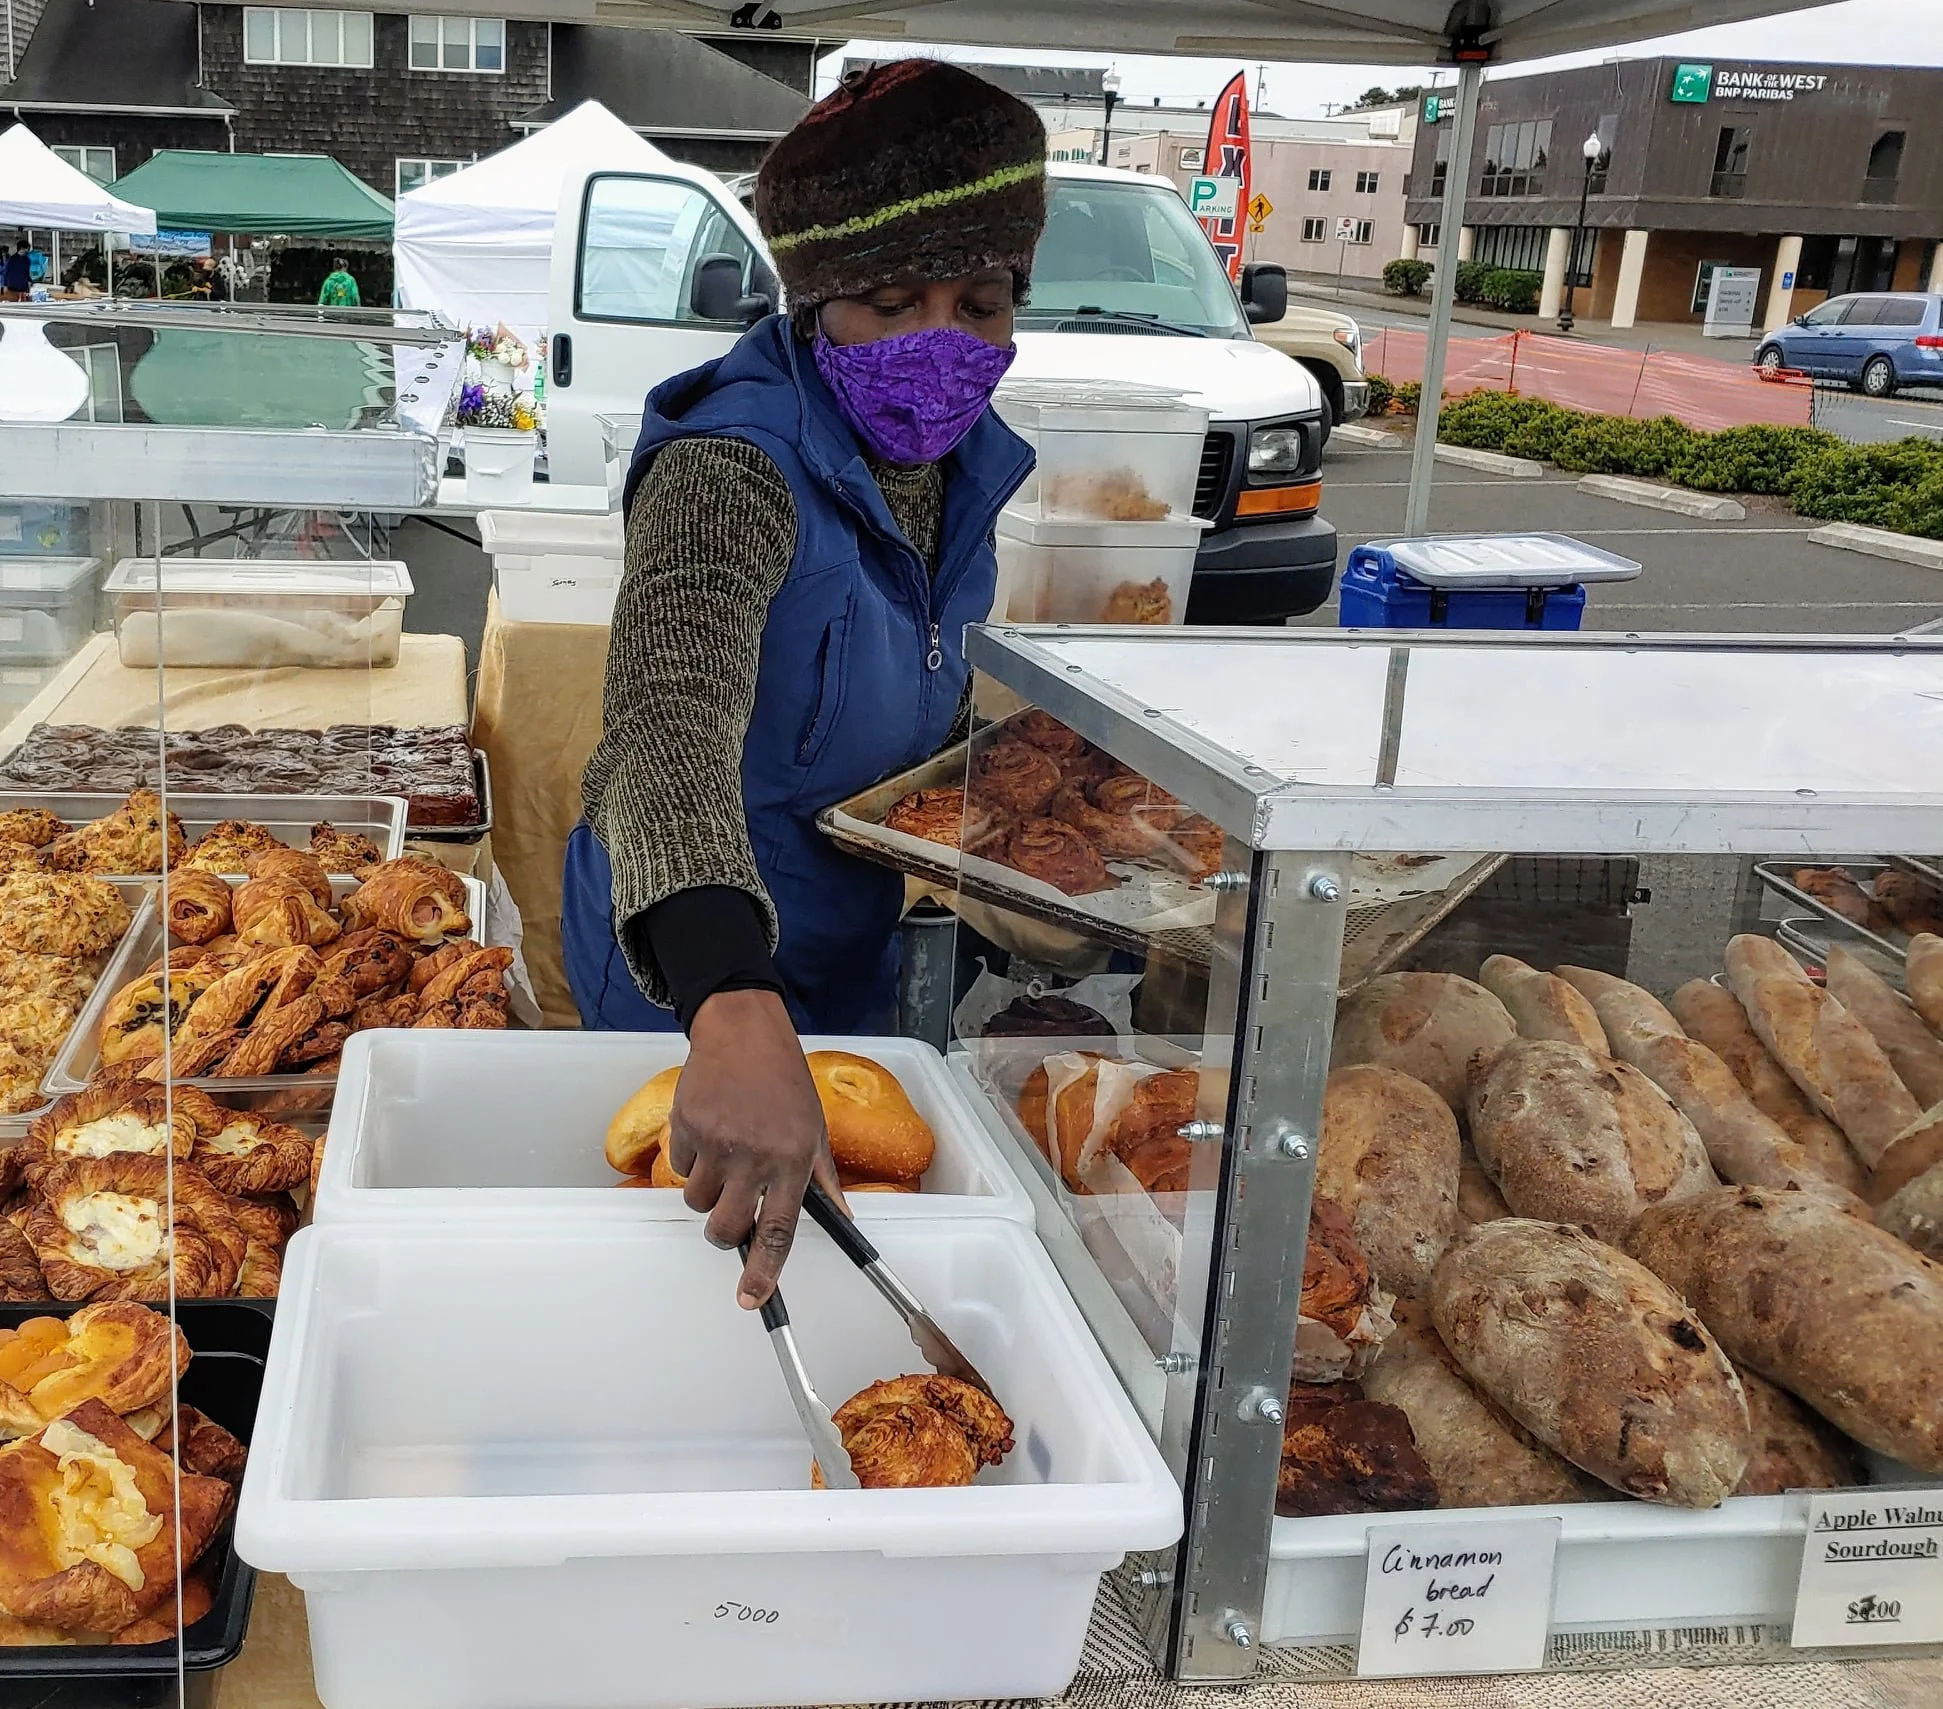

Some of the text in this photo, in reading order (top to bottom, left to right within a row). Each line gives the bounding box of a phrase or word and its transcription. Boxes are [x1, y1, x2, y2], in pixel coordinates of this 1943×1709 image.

[1717, 71, 1764, 87] BANK
[1763, 80, 1779, 88] THE
[1779, 74, 1827, 90] WEST
[1715, 87, 1794, 100] BNP PARIBAS
[1192, 180, 1233, 214] PARKING
[1815, 1509, 1877, 1531] Apple
[1382, 1544, 1503, 1574] Cinnamon
[1825, 1537, 1939, 1561] Sourdough
[1426, 1574, 1495, 1602] bread
